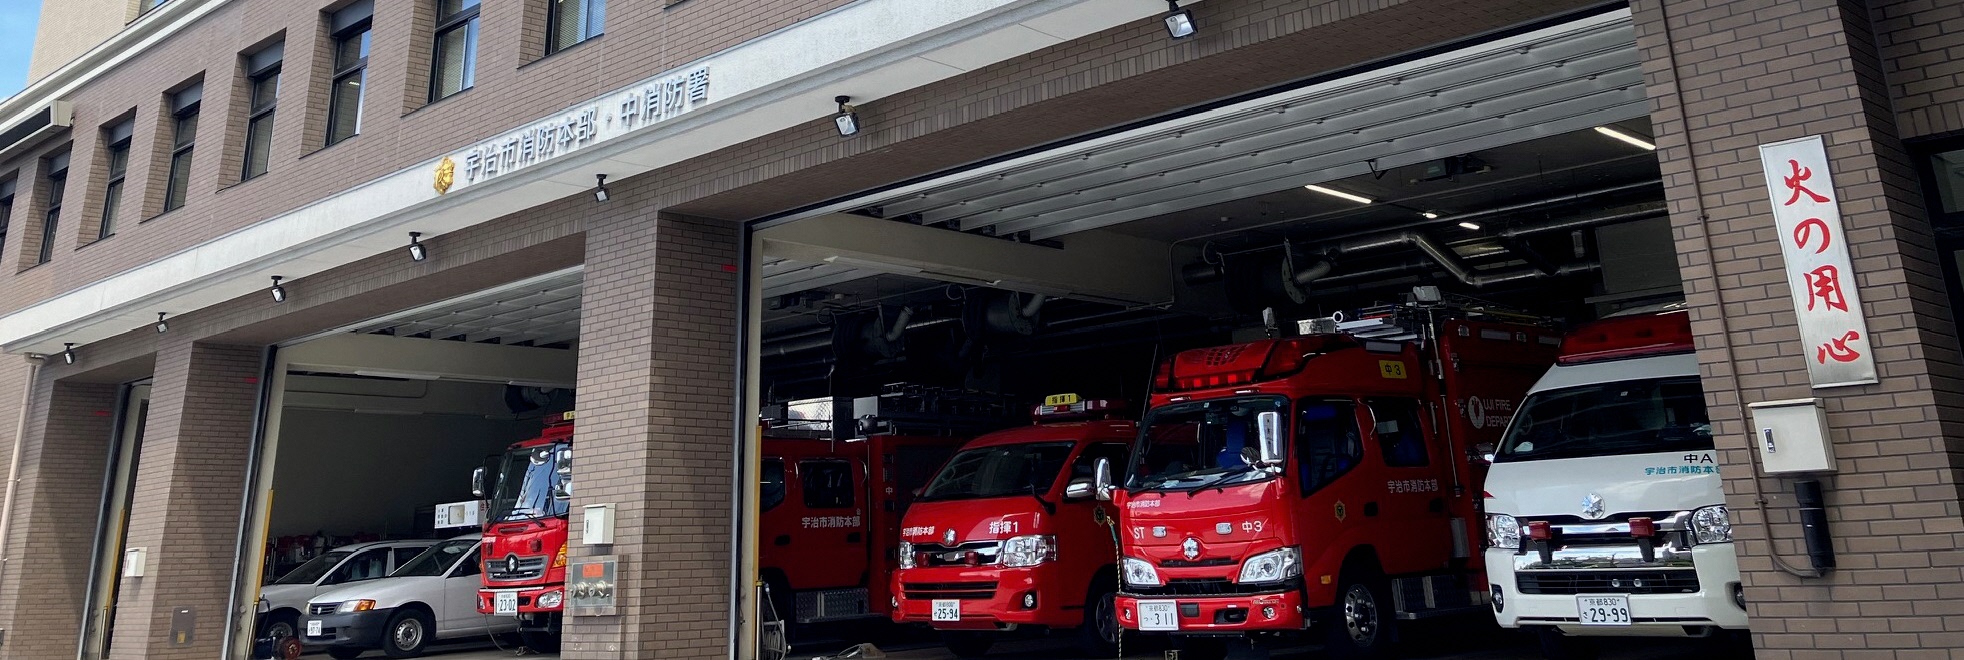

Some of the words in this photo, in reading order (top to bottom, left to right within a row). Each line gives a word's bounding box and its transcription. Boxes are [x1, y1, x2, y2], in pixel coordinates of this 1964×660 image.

[1784, 159, 1861, 364] 火の用心
[1384, 363, 1401, 376] 中3
[1483, 398, 1495, 410] UJI
[1495, 399, 1511, 411] FIRE
[1683, 453, 1713, 464] 中A
[1387, 479, 1438, 493] 宇治市消防本部
[802, 516, 860, 528] 宇治市消防本部
[989, 521, 1019, 535] 指揮1
[1242, 521, 1262, 533] 中3
[1134, 527, 1144, 539] ST
[937, 608, 958, 620] 25-94
[1590, 608, 1628, 622] 29-99
